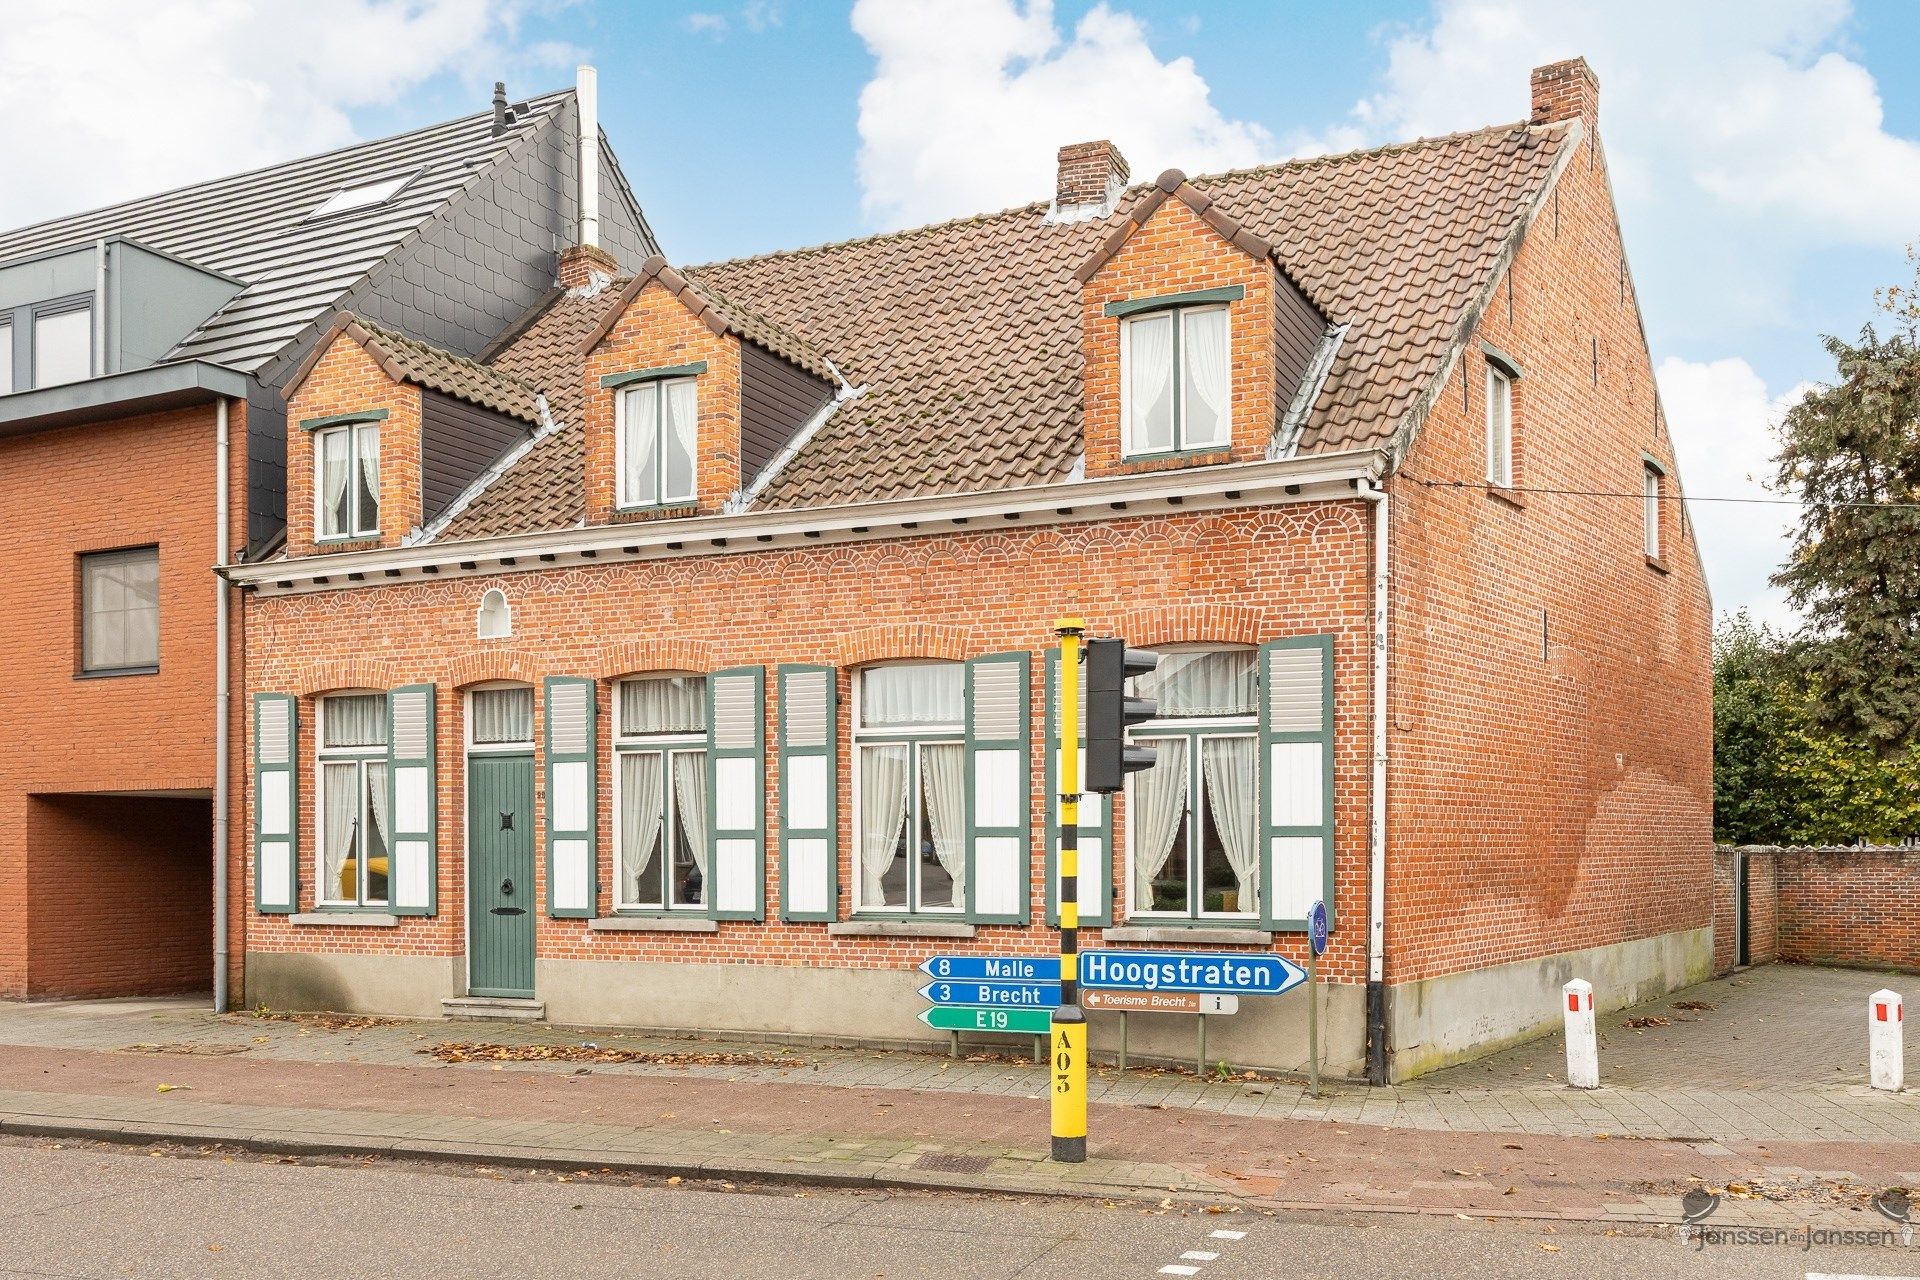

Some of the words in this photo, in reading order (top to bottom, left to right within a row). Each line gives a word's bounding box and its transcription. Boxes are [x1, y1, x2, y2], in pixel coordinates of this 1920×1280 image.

[939, 959, 951, 976] 8
[985, 960, 1034, 977] Malle
[1089, 956, 1270, 989] Hoogstraten
[940, 984, 951, 1001] 3
[979, 985, 1040, 1003] Brecht
[1103, 994, 1147, 1006] Toerisme
[1151, 996, 1186, 1007] Brecht
